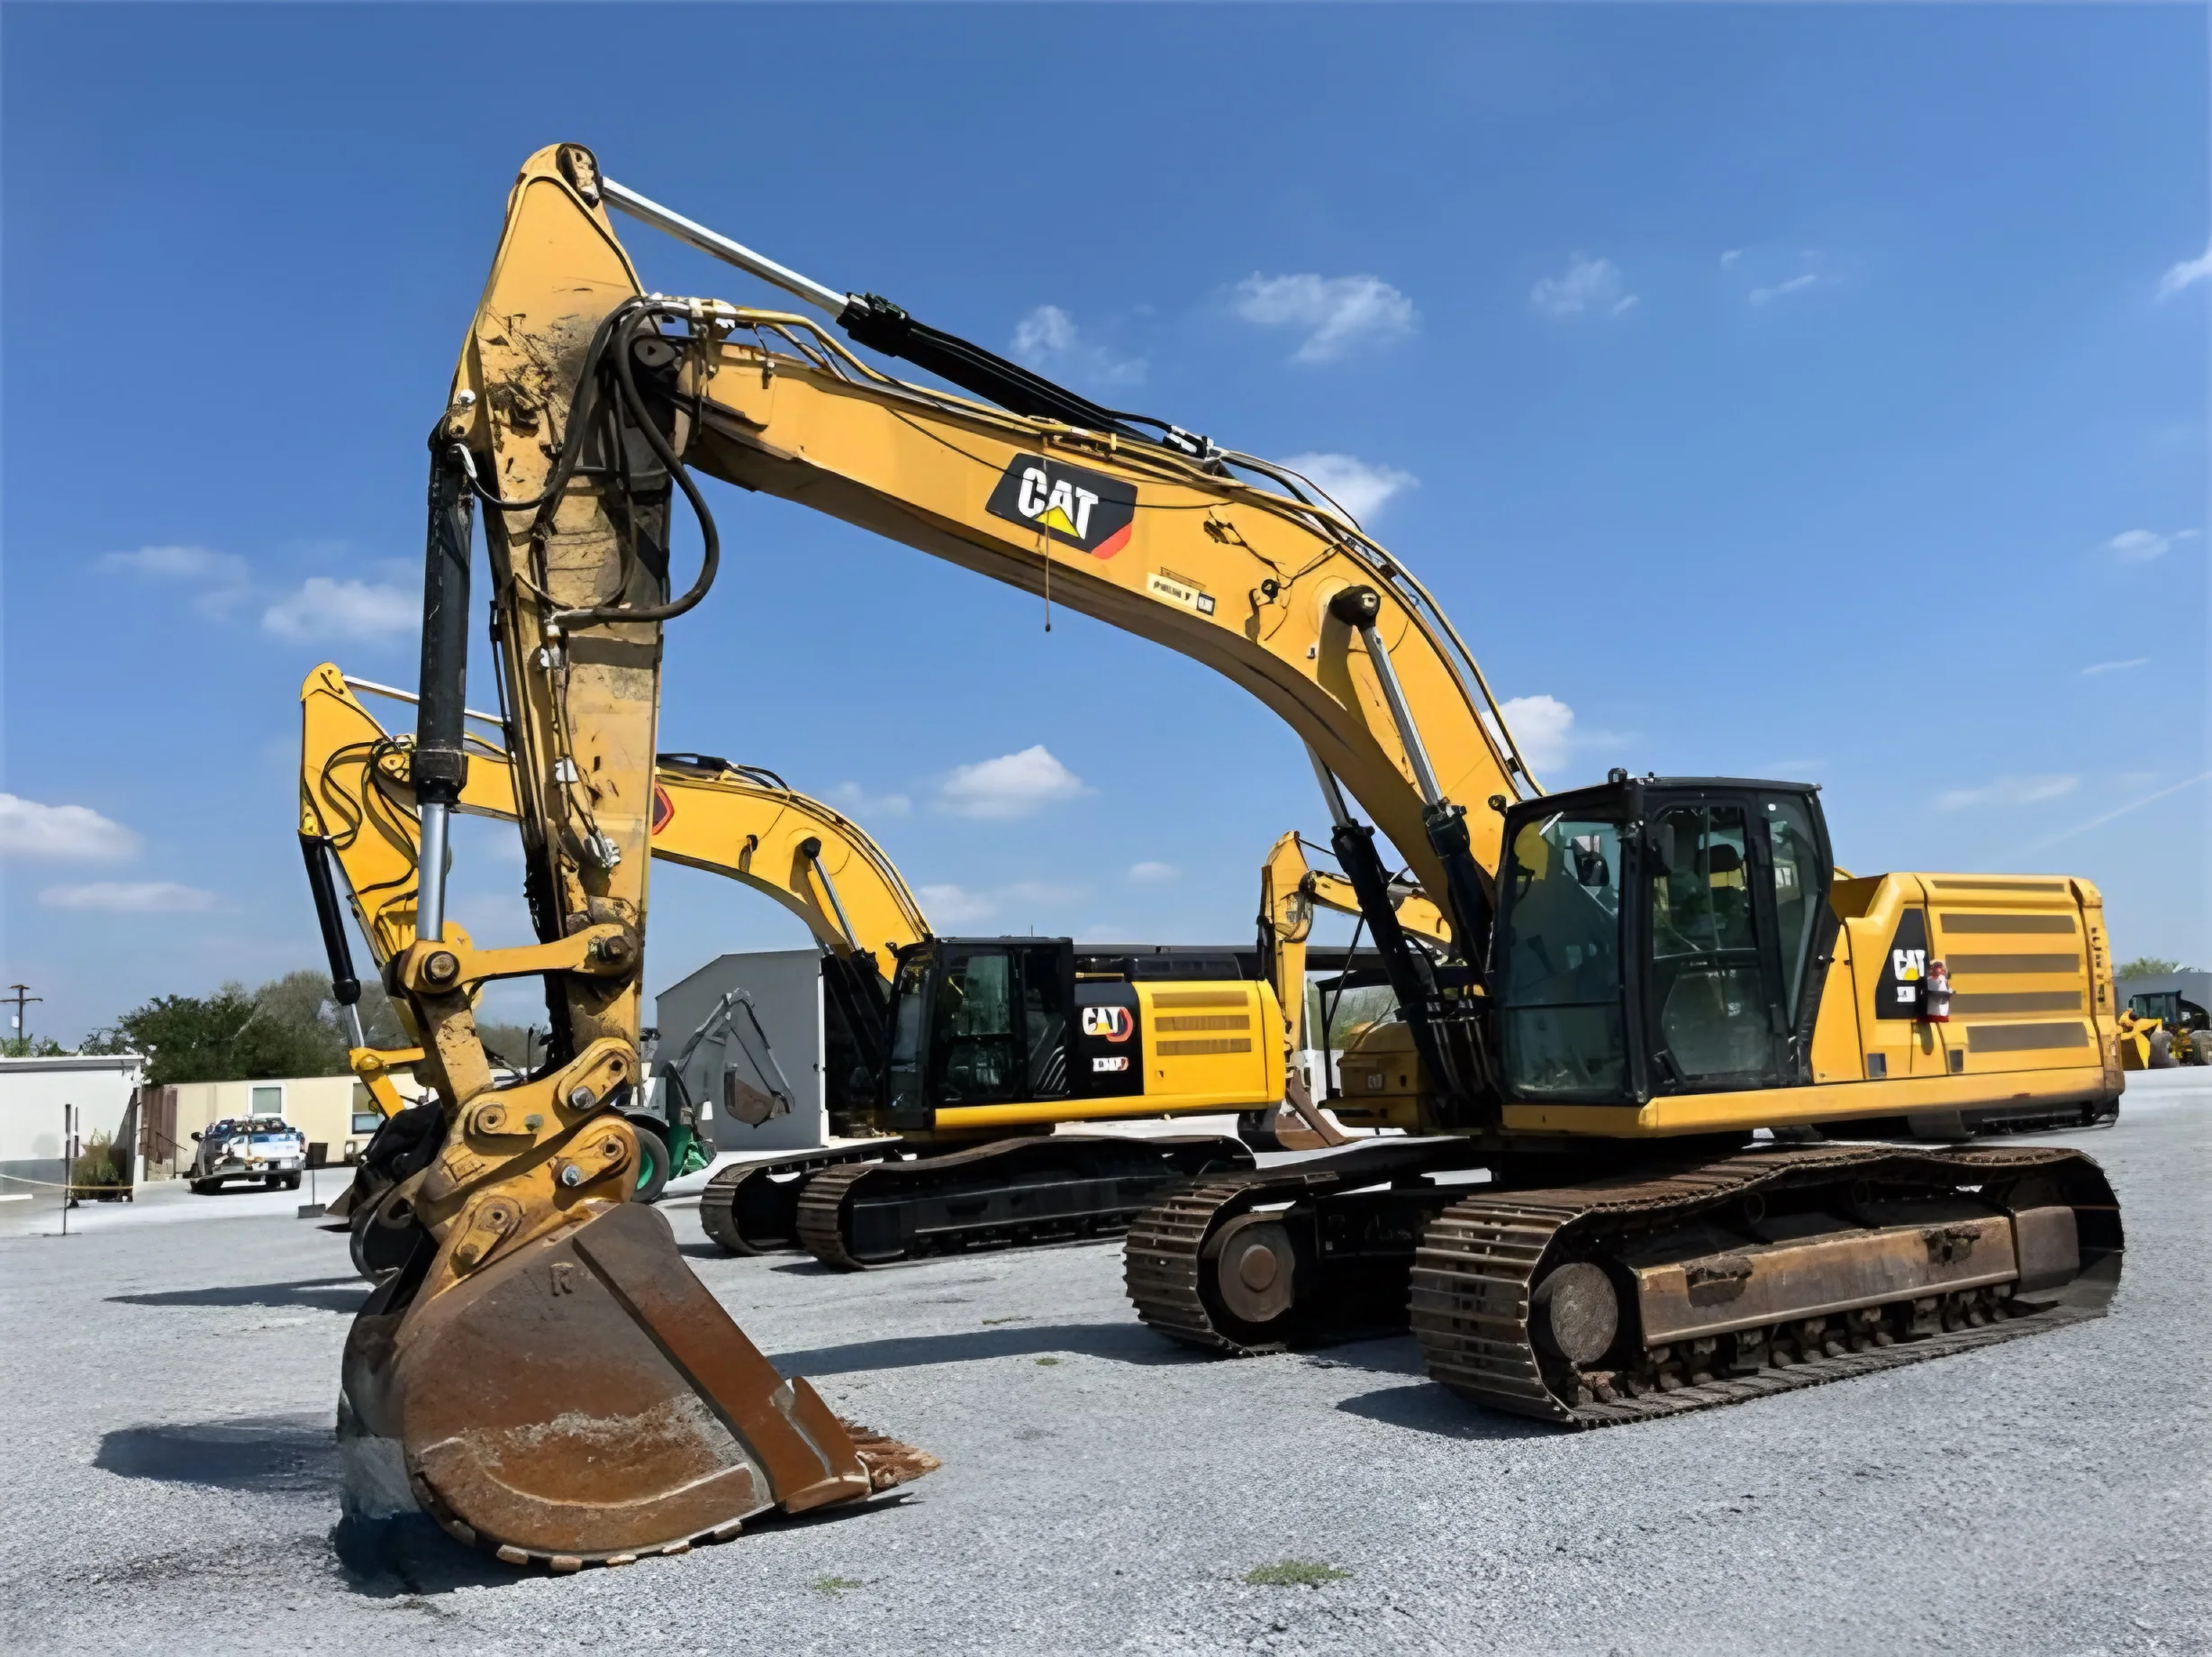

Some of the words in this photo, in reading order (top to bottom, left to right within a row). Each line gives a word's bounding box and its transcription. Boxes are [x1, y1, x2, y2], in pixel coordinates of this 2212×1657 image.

[1018, 466, 1099, 540] CAT
[1893, 949, 1926, 981] CAT
[1083, 1007, 1120, 1035] CAT
